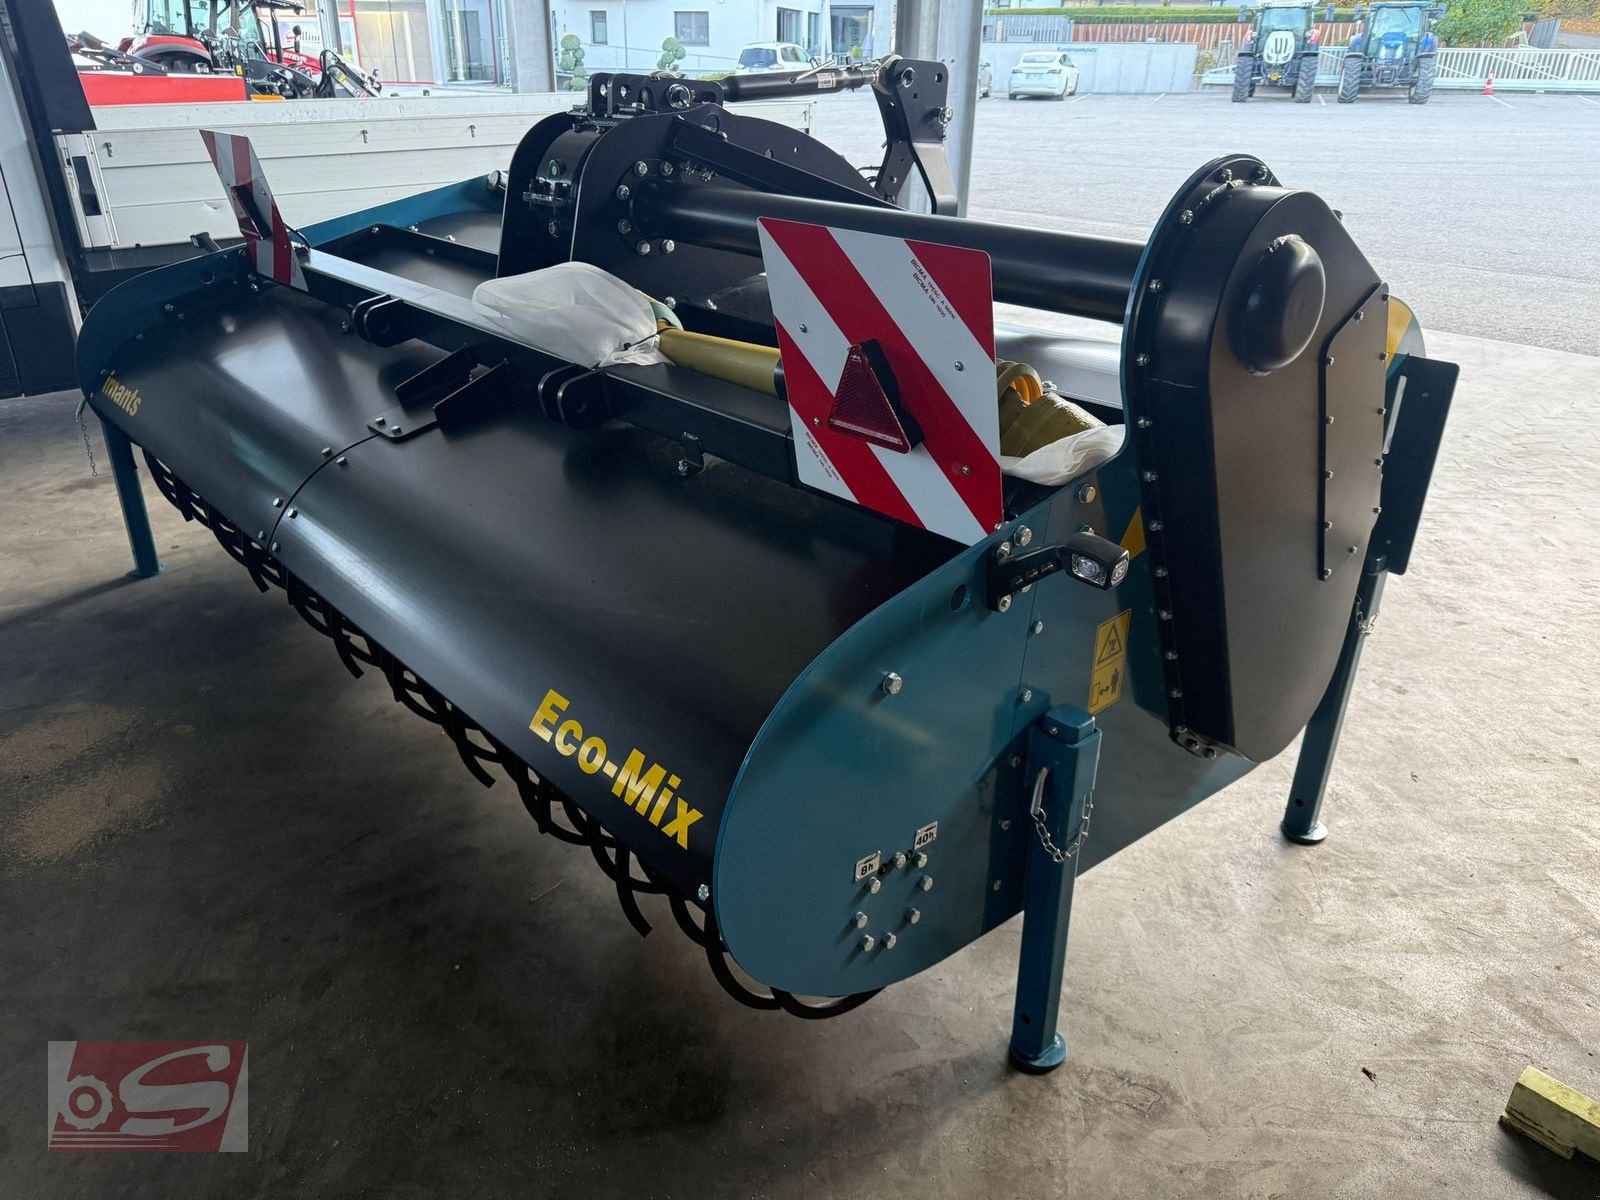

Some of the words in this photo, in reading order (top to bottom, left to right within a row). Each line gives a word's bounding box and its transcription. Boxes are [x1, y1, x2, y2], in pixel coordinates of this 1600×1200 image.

[911, 259, 927, 280] BICMA
[913, 273, 929, 294] BICMA
[528, 688, 704, 851] Eco-Mix
